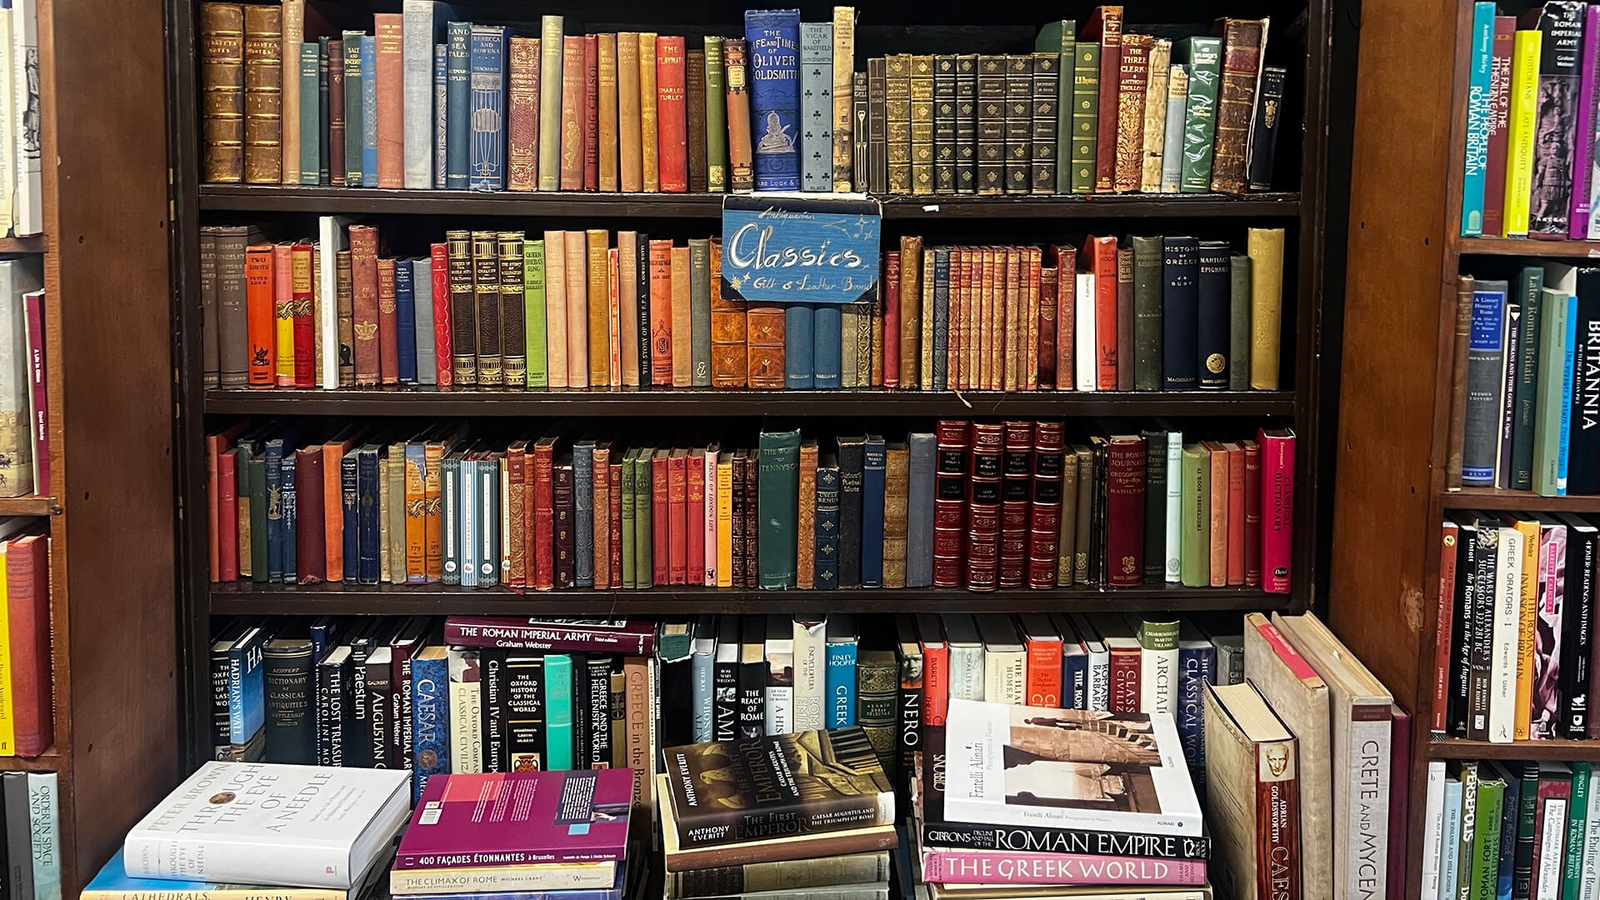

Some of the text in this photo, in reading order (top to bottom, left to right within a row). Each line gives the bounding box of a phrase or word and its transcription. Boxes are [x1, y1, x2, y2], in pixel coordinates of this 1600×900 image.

[754, 53, 795, 68] OLIVER
[1479, 24, 1489, 73] Anthony Birley
[1498, 57, 1510, 128] THE FALL OF THE
[1466, 86, 1481, 175] ROMAN BRITAIN
[1479, 92, 1491, 169] THE PEOPLE OF
[758, 206, 815, 226] Antiquarian
[727, 222, 862, 269] Classics
[753, 274, 873, 291] Gilt & Leather Bound
[1524, 275, 1539, 384] Later Roman Britain
[1582, 320, 1600, 430] BRITANNIA
[1274, 473, 1282, 532] DICTIONARY
[1283, 477, 1291, 528] CLASSICAL
[1505, 539, 1516, 615] GREEK ORATORS
[1463, 585, 1473, 618] Romans
[1474, 560, 1486, 653] SUCCESSORS BC
[1482, 553, 1495, 661] THE WARS OF ALEXANDER'S
[460, 628, 591, 641] THE ROMAN IMPERIAL ARMY
[525, 641, 552, 649] Webster
[1461, 643, 1471, 656] Age
[1526, 620, 1534, 658] ROMAN
[1461, 657, 1469, 665] of
[1461, 666, 1469, 697] Augustus
[231, 659, 241, 736] HADRIAN'S WALL
[321, 688, 329, 742] CAROLINE
[331, 672, 340, 720] THE LOST
[355, 666, 366, 719] Paestum
[393, 694, 401, 718] Graham
[402, 660, 411, 756] THE ROMAN IMPERIAL
[417, 679, 436, 746] CAESAR
[458, 688, 468, 736] CLASSICAL
[488, 660, 500, 737] Christian IV and
[599, 679, 607, 709] GREECE
[836, 686, 847, 725] GREEK
[1186, 658, 1198, 729] CLASSICAL
[373, 692, 385, 759] AUGUSTAN
[631, 672, 644, 764] GREECE in the
[904, 694, 918, 746] NERO
[31, 790, 40, 815] AND
[969, 771, 984, 799] Fratelli
[1362, 741, 1379, 829] CRETE AND
[1463, 767, 1477, 842] PERSEPOLIS
[40, 786, 52, 868] ORDER IN SPACE
[688, 825, 730, 836] ANTHONY
[693, 833, 725, 842] EVERITT
[734, 818, 811, 841] EMPEROR
[744, 812, 796, 824] THE FIRST
[1271, 786, 1279, 844] GOLDSWORTHY
[419, 856, 434, 864] 400
[437, 854, 471, 864] FAÇADES
[474, 852, 525, 863] ÉTONNANTES
[995, 830, 1176, 857] ROMAN EMPIRE
[1483, 838, 1491, 862] FORT
[1586, 819, 1599, 875] The Ending of
[406, 878, 422, 886] THE
[424, 877, 458, 885] CLIMAX
[473, 875, 497, 883] ROME
[946, 858, 1168, 879] THE GREEK WORLD
